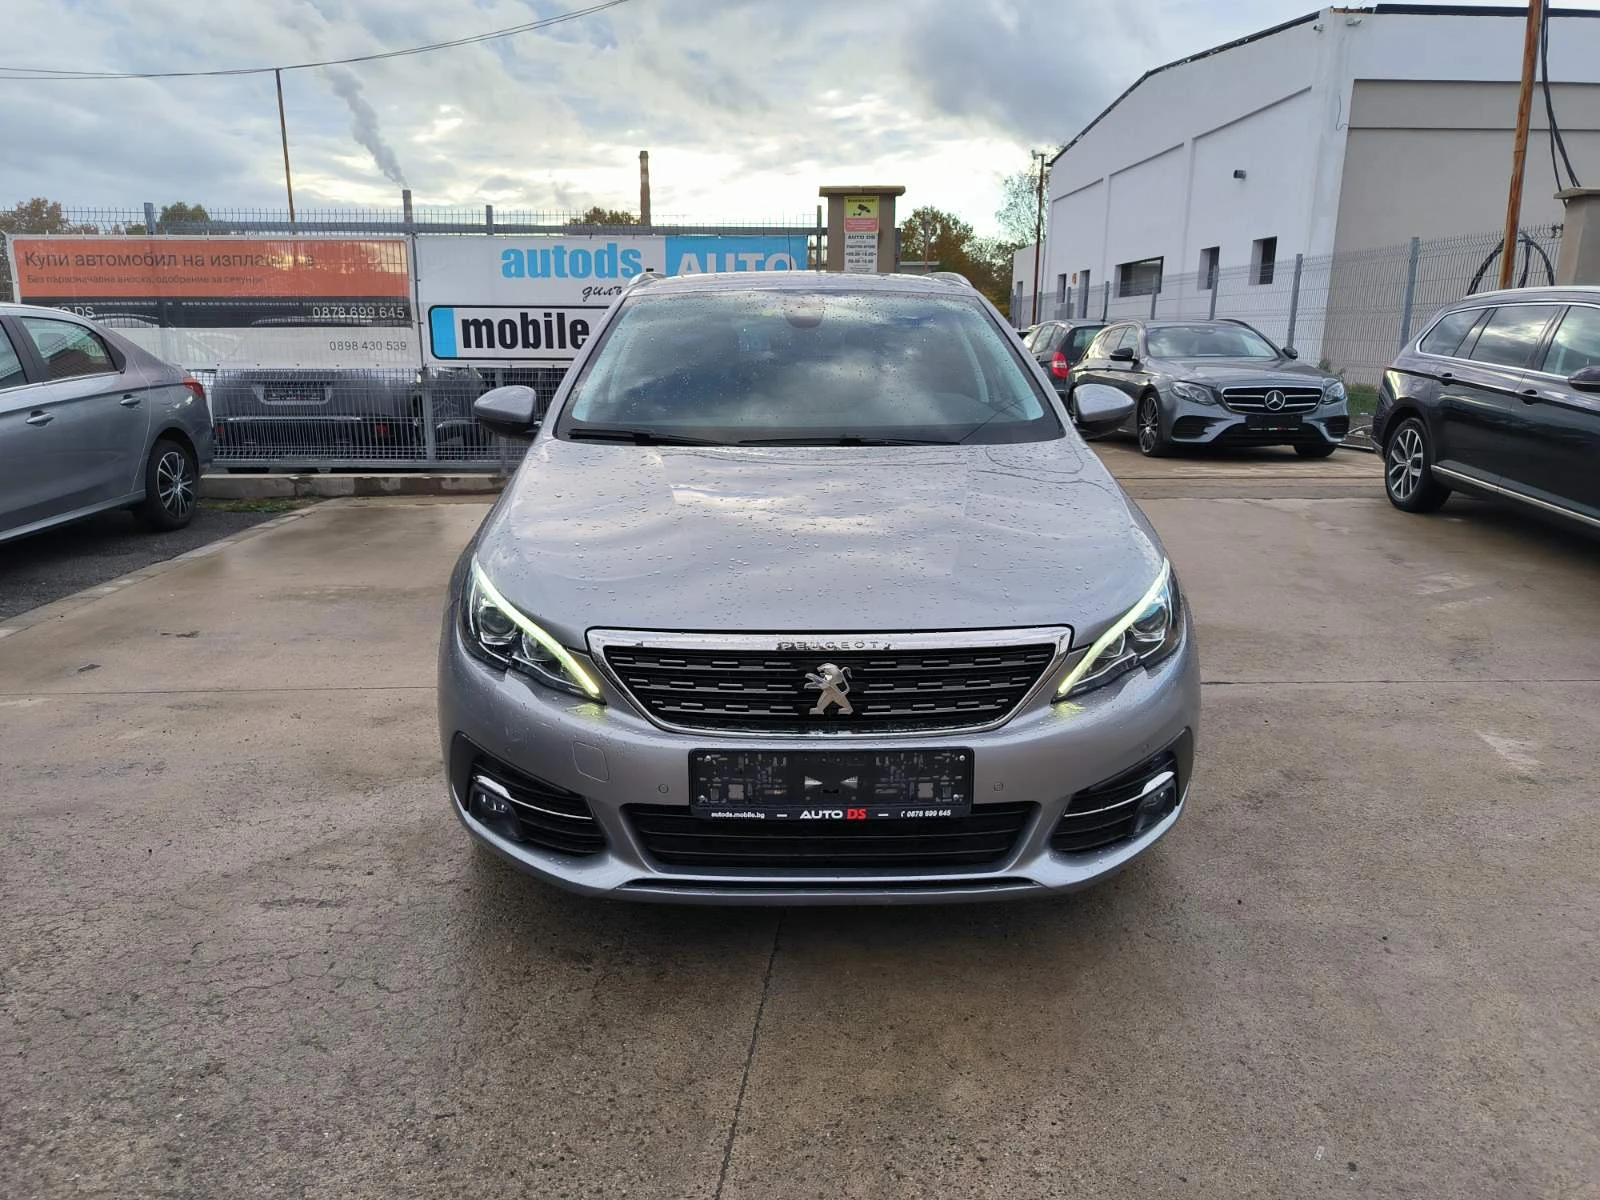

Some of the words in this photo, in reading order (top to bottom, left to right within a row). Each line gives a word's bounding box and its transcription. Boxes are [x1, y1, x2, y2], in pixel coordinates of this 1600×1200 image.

[25, 251, 69, 269] Купи
[75, 252, 177, 267] автомобил
[183, 254, 205, 267] на
[501, 243, 643, 280] autods
[27, 274, 44, 284] Без
[312, 306, 345, 318] 0878
[350, 306, 375, 318] 699
[379, 306, 405, 318] 645
[461, 312, 590, 350] mobile
[329, 341, 359, 351] 0898
[361, 341, 383, 351] 430
[386, 341, 407, 351] 539
[780, 641, 879, 649] PEUGEOT
[799, 810, 844, 819] AUTO
[846, 808, 867, 820] DS
[938, 809, 952, 817] 645
